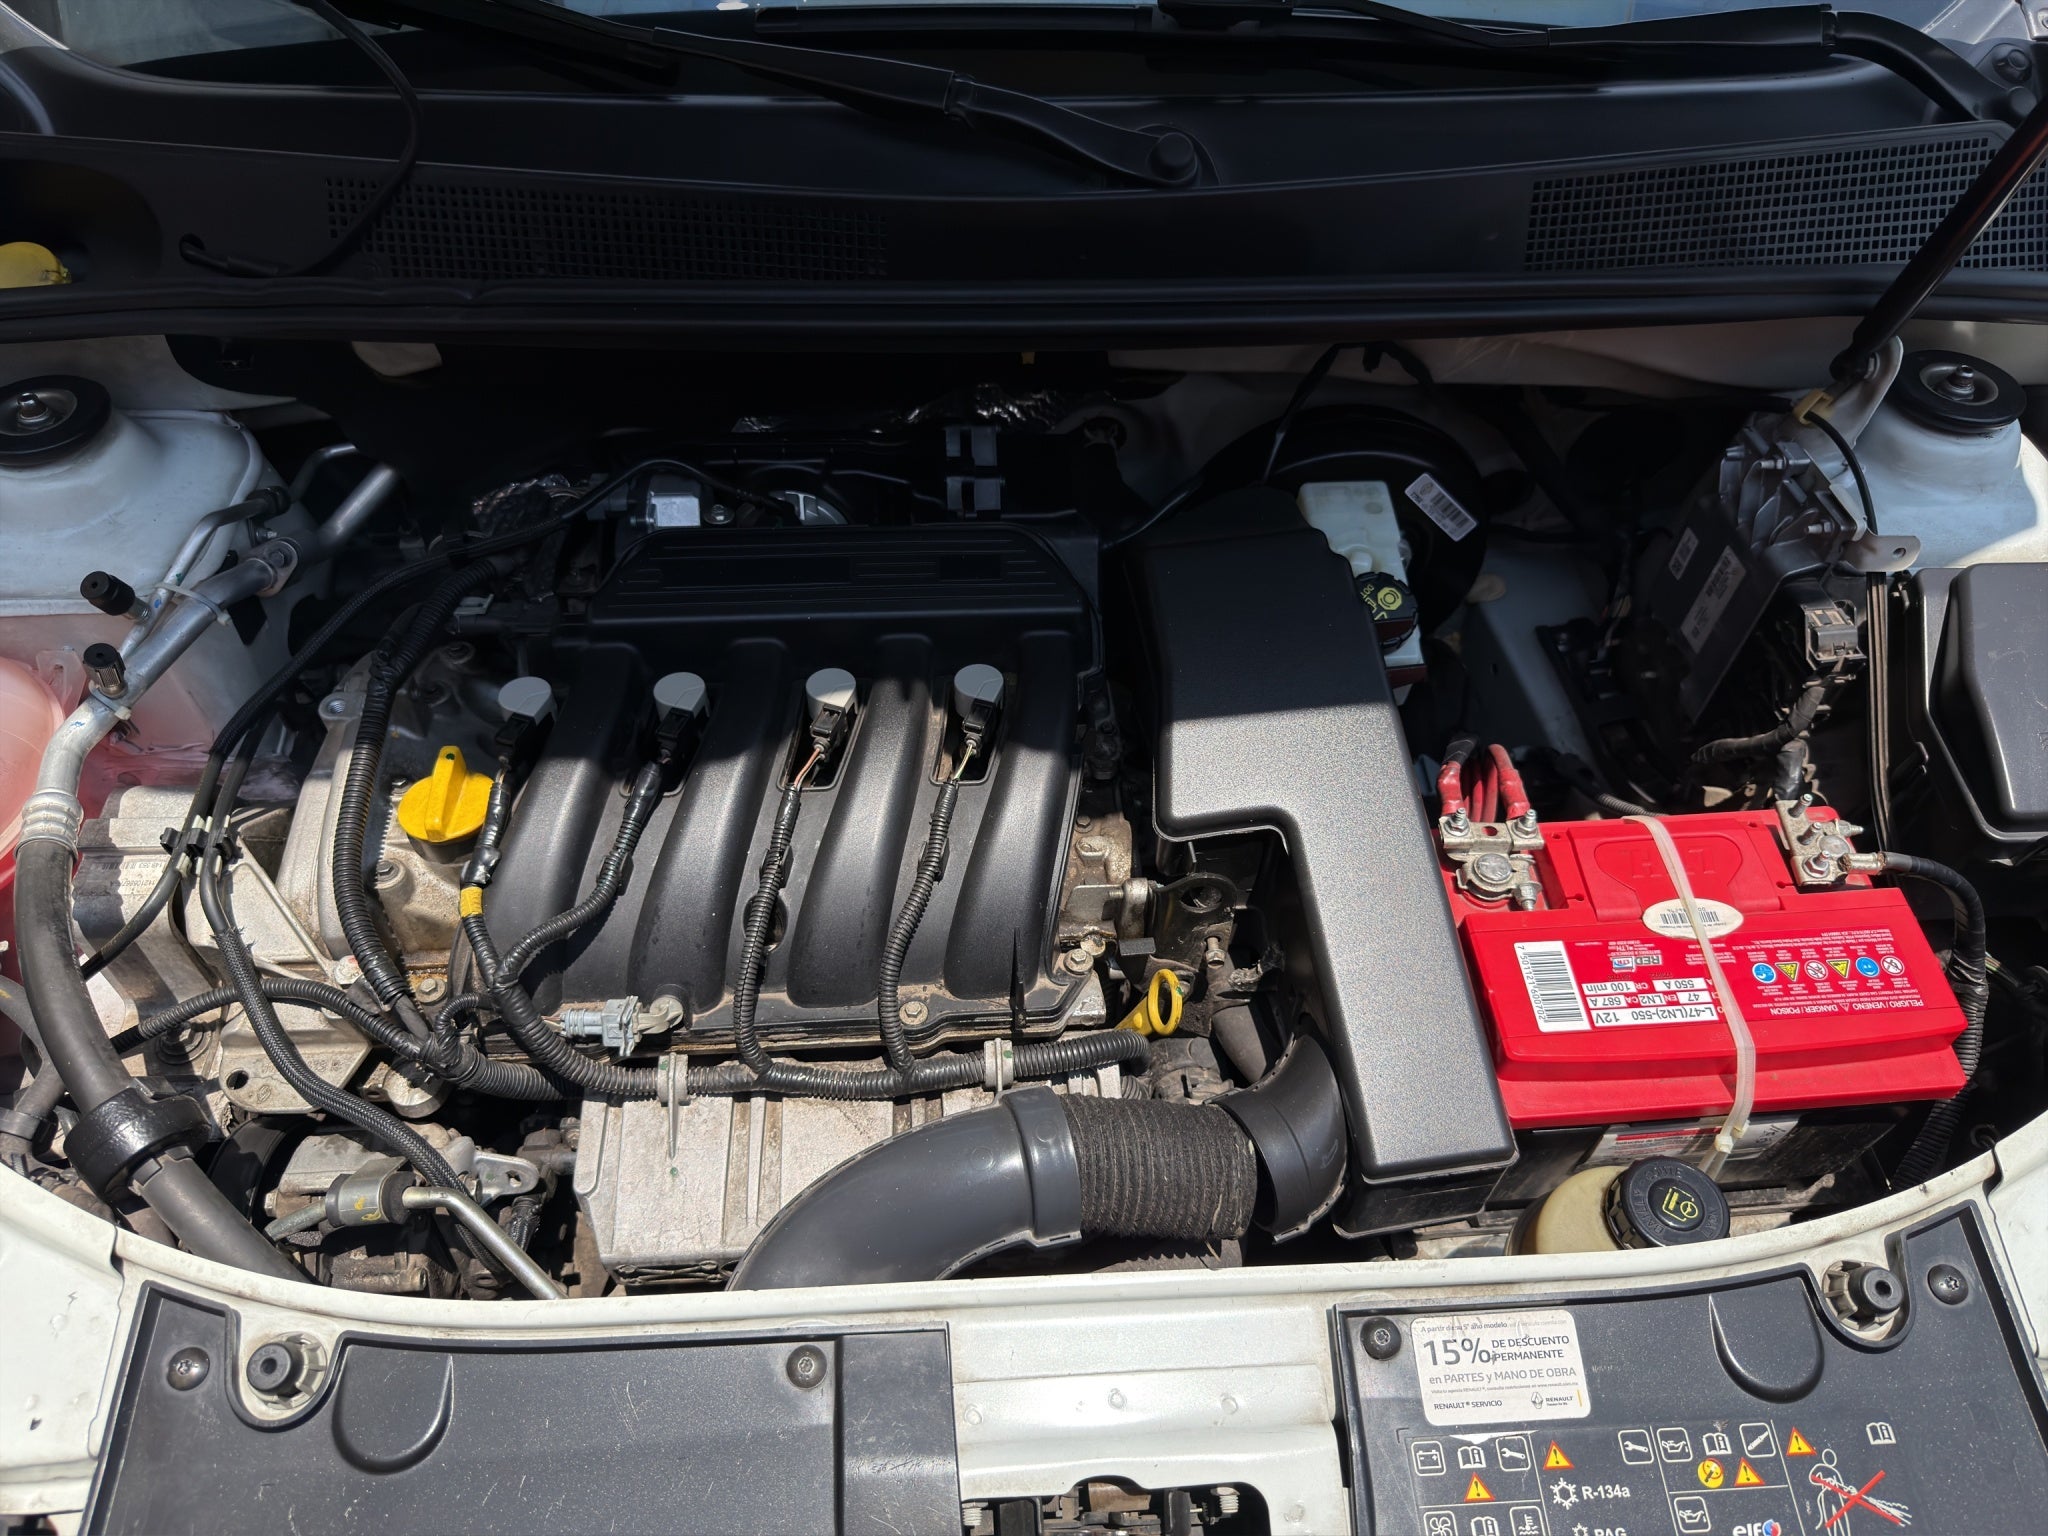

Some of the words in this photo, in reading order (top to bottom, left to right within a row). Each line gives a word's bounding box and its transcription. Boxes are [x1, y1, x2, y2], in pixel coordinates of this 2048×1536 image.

[1635, 956, 1660, 966] RED
[1585, 983, 1608, 994] min
[1610, 982, 1630, 992] 100
[1635, 981, 1648, 990] CR
[1662, 981, 1672, 990] A
[1674, 979, 1694, 990] 550
[1589, 997, 1598, 1007] A
[1601, 996, 1621, 1006] 687
[1625, 995, 1638, 1004] CA
[1640, 994, 1663, 1005] LN2
[1664, 993, 1677, 1003] EN
[1688, 993, 1701, 1003] 47
[1804, 1004, 1838, 1013] DANGER
[1852, 1001, 1885, 1011] VENENO
[1889, 999, 1924, 1009] PELIGRO
[1631, 1005, 1714, 1021] L-47(LN2)-550
[1769, 1006, 1800, 1016] POISON
[1595, 1011, 1620, 1024] 12V
[1483, 1321, 1508, 1329] modelo
[1423, 1337, 1491, 1366] 15%
[1491, 1338, 1506, 1348] DE
[1508, 1335, 1570, 1348] DESCUENTO
[1495, 1349, 1565, 1362] PERMANENTE
[1429, 1375, 1442, 1385] en
[1444, 1372, 1484, 1383] PARTES
[1487, 1374, 1494, 1384] y
[1494, 1370, 1527, 1381] MANO
[1530, 1368, 1544, 1378] DE
[1546, 1367, 1577, 1377] OBRA
[1471, 1399, 1503, 1408] SERVICIO
[1545, 1395, 1573, 1403] RENAULT
[1581, 1484, 1631, 1500] R-134a
[1732, 1522, 1764, 1536] elf
